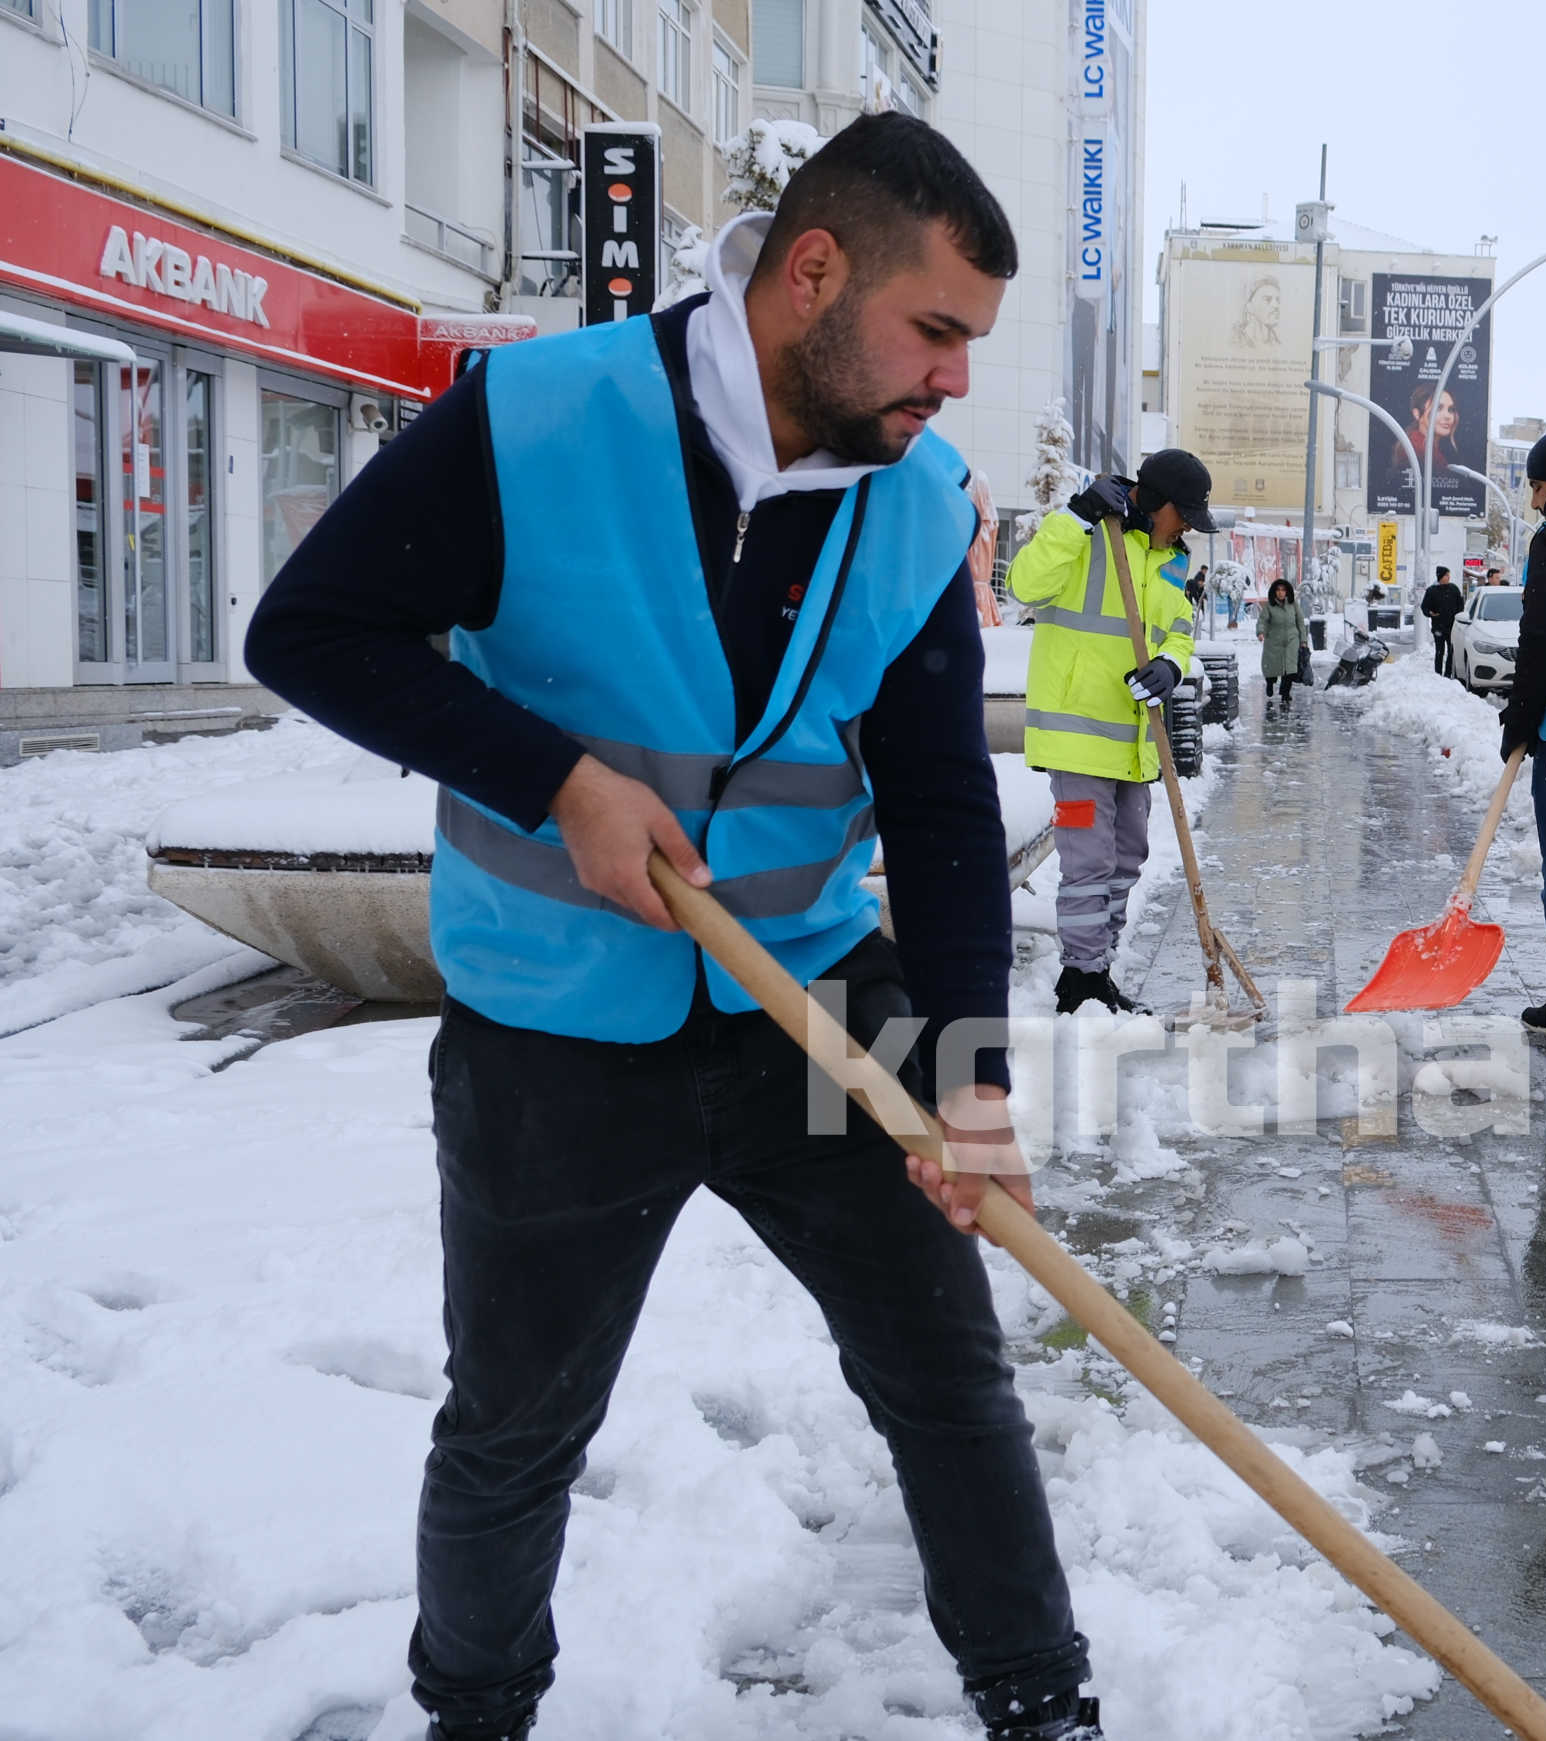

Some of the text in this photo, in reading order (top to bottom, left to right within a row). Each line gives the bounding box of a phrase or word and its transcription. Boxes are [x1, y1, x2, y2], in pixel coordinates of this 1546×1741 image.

[1083, 65, 1104, 98] LC
[1082, 247, 1102, 280] LC
[101, 224, 270, 329] AKBANK
[1387, 292, 1446, 309] KADINLARA
[1383, 306, 1408, 325] TEK
[434, 325, 520, 341] AKBANK
[1386, 324, 1430, 341] GÜZELLİK
